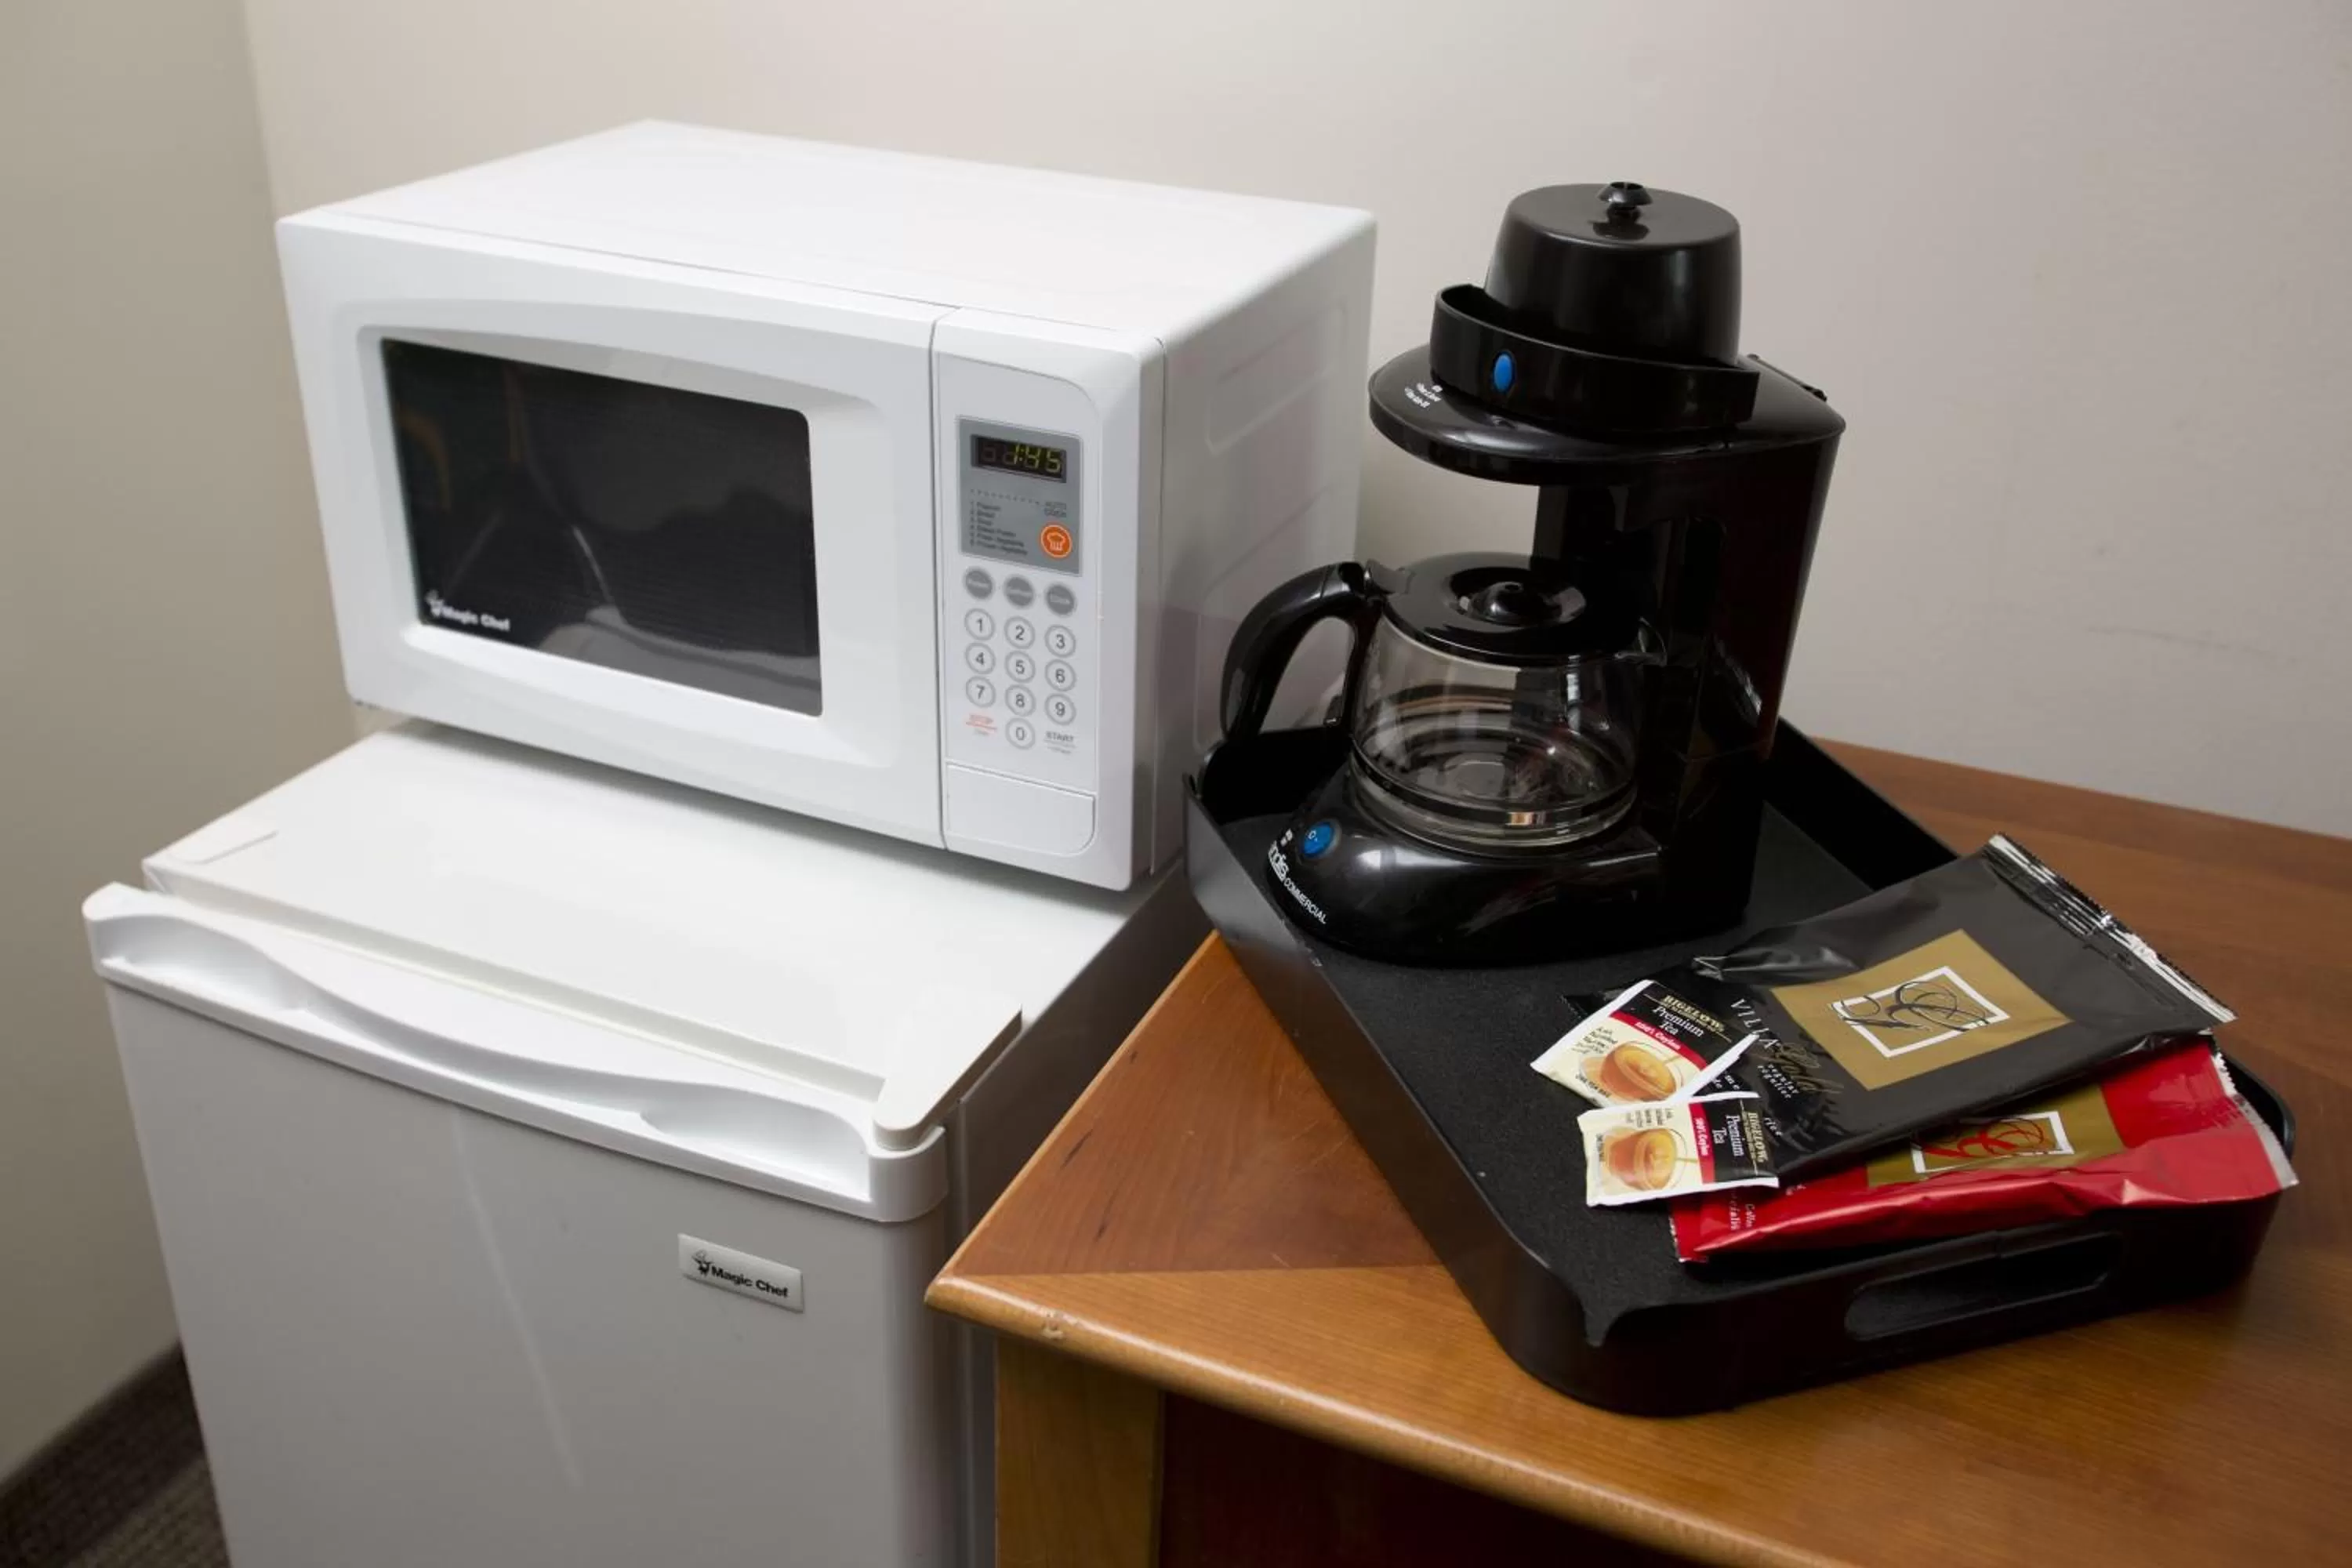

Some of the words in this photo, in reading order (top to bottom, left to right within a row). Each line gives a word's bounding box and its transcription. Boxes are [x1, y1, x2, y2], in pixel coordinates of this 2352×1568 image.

[1046, 731, 1074, 742] START
[1652, 1006, 1704, 1036] Premium
[1659, 1020, 1679, 1035] Tea
[1711, 1127, 1727, 1145] Tea
[1726, 1115, 1745, 1156] Premium
[1747, 1112, 1768, 1161] BIGELOW
[711, 1265, 753, 1287] Magic
[756, 1279, 789, 1298] Chef
